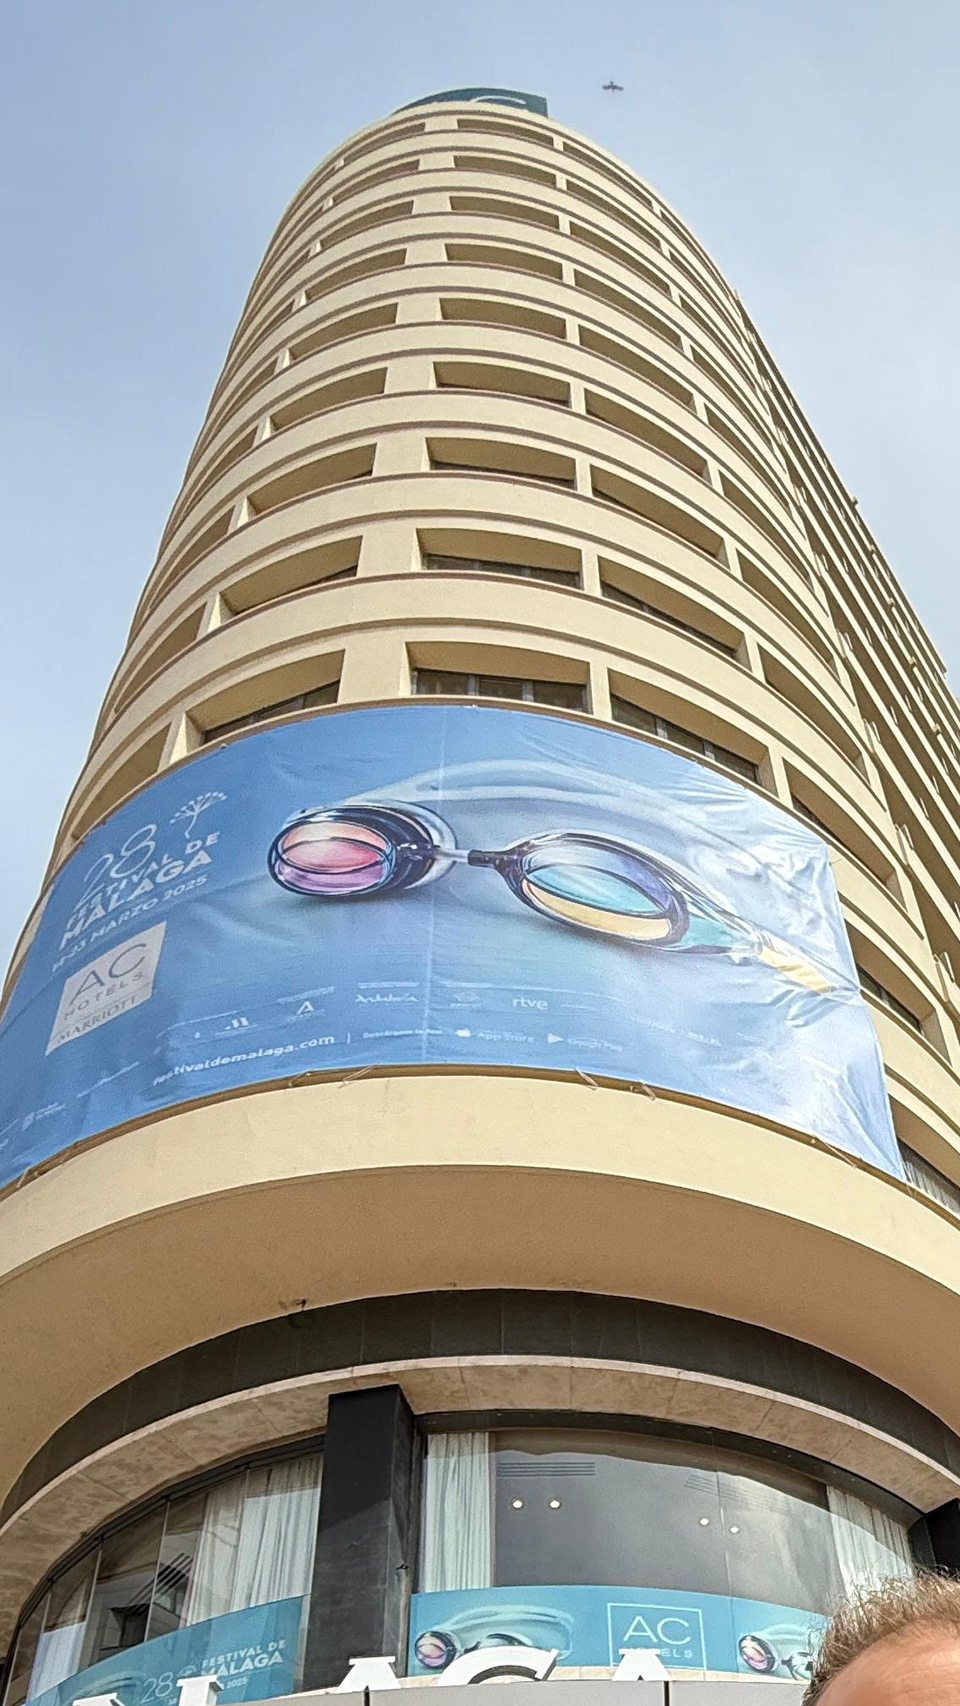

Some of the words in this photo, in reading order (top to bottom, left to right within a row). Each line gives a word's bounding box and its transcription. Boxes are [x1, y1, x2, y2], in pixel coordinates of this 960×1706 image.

[66, 853, 174, 931] FESTIVAL
[185, 831, 221, 856] DE
[70, 823, 157, 915] 28
[161, 874, 209, 903] 2025
[64, 971, 143, 1021] HOTELS
[69, 943, 147, 1006] AC
[58, 996, 136, 1043] MARRIOTT
[512, 996, 549, 1010] rtve
[152, 1035, 335, 1087] festivaldemalaga.com
[623, 1614, 691, 1645] AC
[202, 1645, 263, 1669] FESTIVAL
[268, 1639, 287, 1651] DE
[140, 1671, 174, 1703] 28
